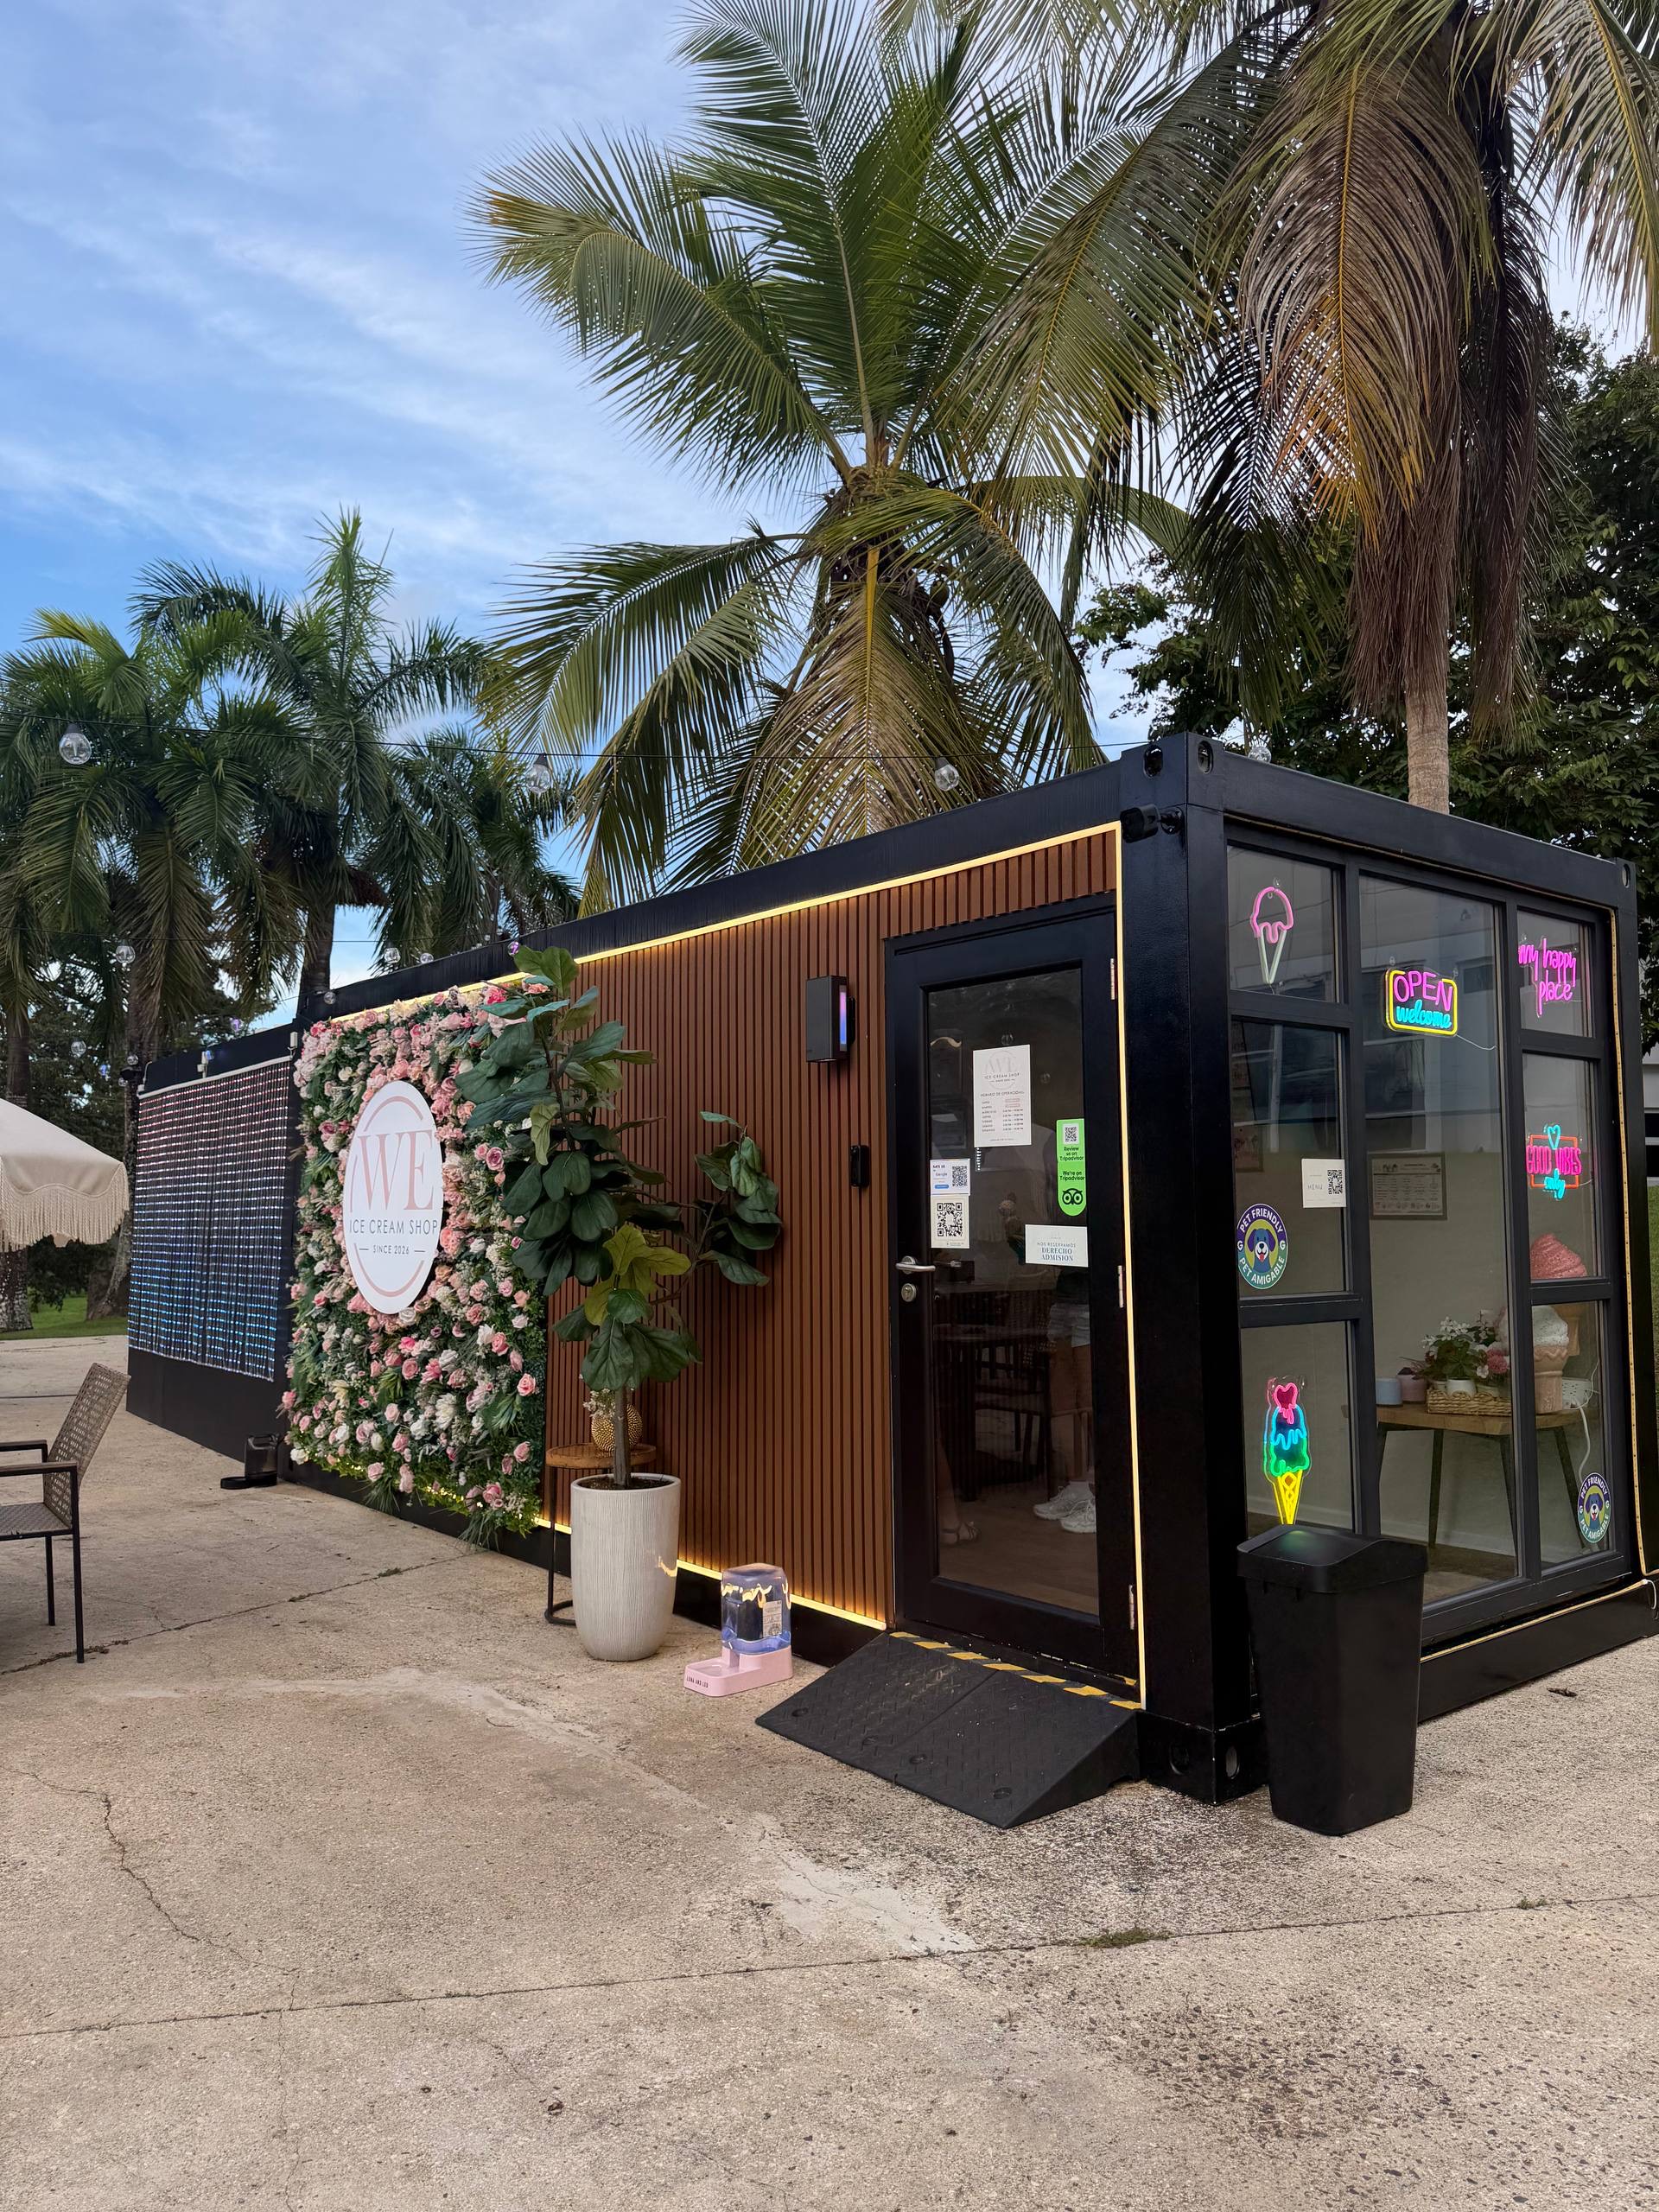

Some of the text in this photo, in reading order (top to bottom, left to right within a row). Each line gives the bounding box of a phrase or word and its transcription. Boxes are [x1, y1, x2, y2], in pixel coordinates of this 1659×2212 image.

[1518, 938, 1577, 987] my happy
[1394, 970, 1452, 1012] OPEN
[1539, 969, 1573, 1015] place
[1396, 999, 1452, 1028] welcome
[357, 1128, 433, 1211] WE
[1526, 1145, 1582, 1175] GOOD VIBES
[349, 1219, 438, 1235] ICE CREAM SHOP
[1240, 1208, 1283, 1233] PET FRIENDLY
[373, 1245, 410, 1255] SINCE 2026
[1237, 1241, 1243, 1251] G
[1280, 1241, 1286, 1250] G
[1239, 1256, 1285, 1285] PET AMIGABLE
[1588, 1476, 1607, 1495] FRIENDLY
[1580, 1514, 1609, 1539] PET AMIGABLE
